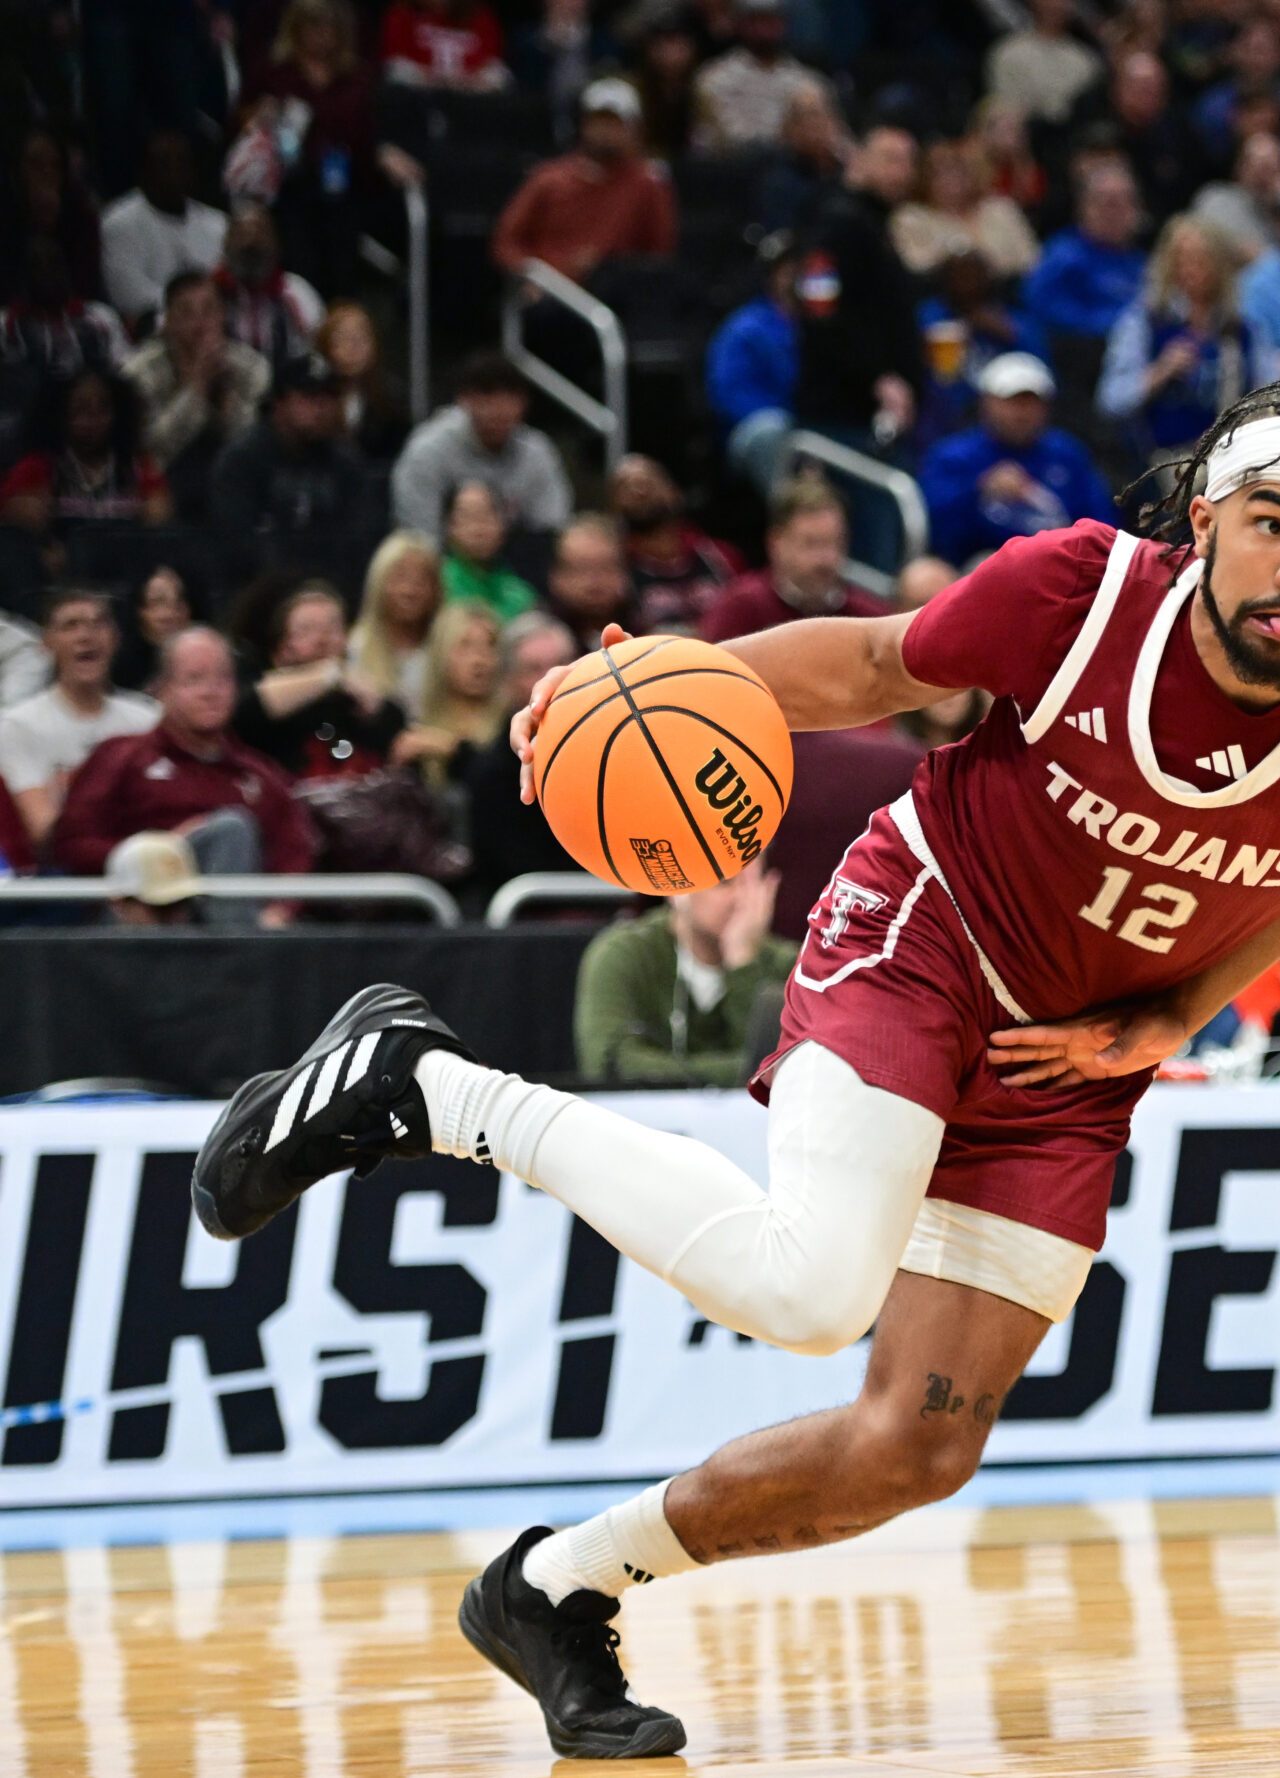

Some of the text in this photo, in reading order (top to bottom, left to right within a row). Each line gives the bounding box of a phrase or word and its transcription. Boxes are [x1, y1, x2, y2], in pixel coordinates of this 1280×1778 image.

[695, 747, 763, 869] Wilso
[715, 827, 729, 846] EVO
[1078, 866, 1199, 954] 12
[0, 1150, 623, 1465] IRST
